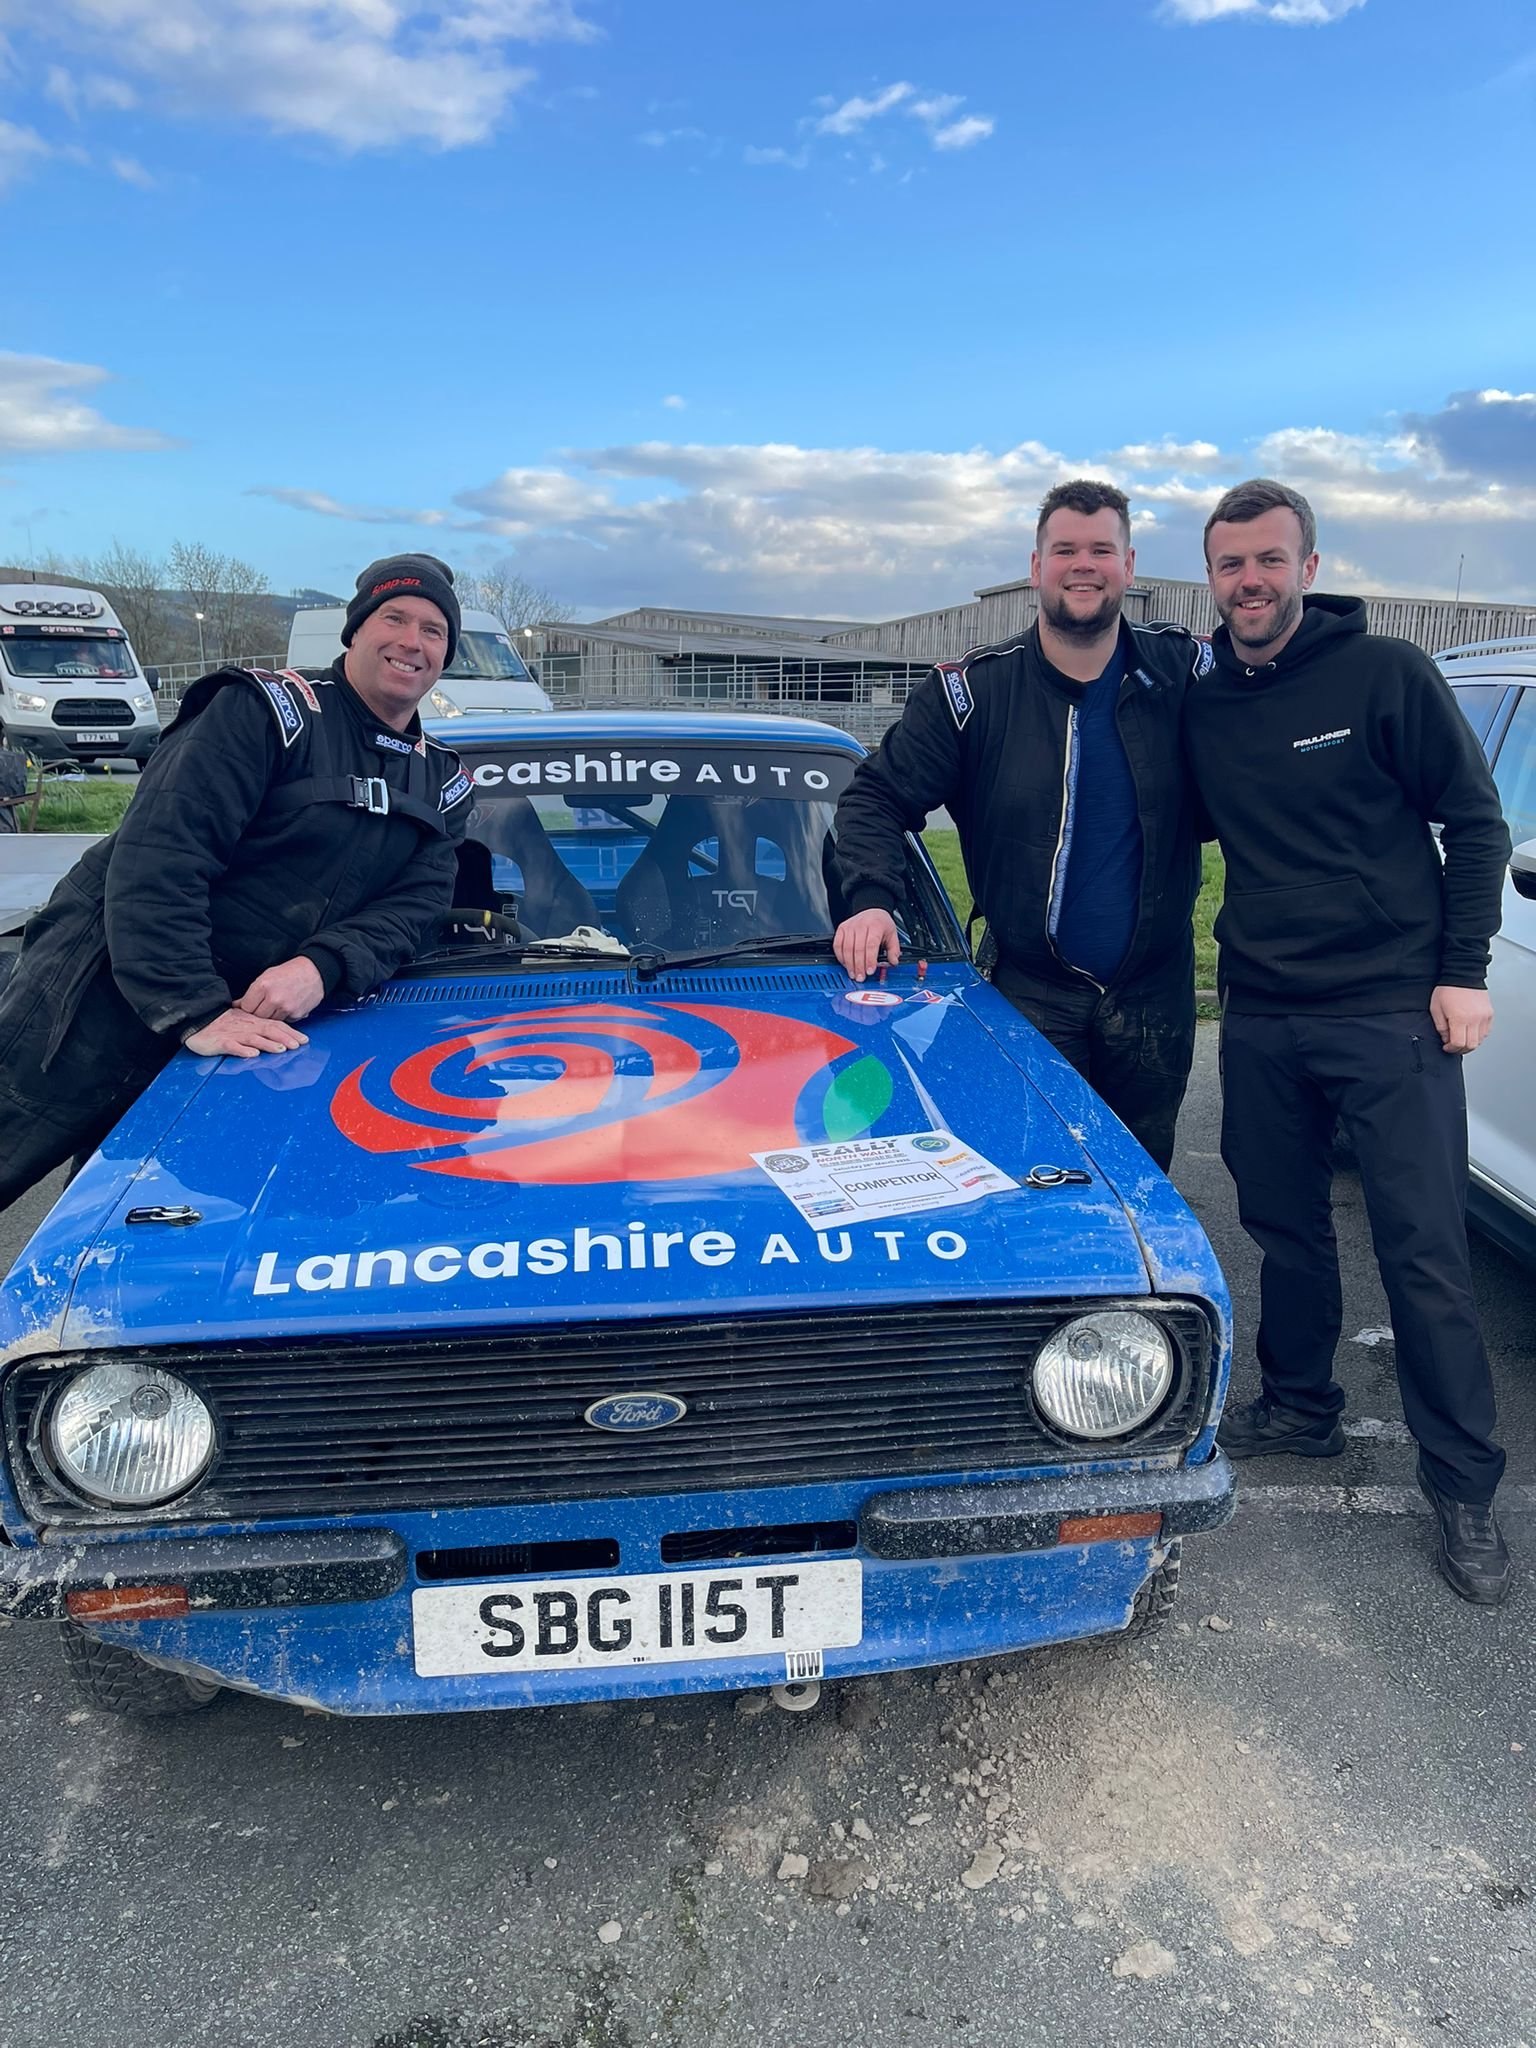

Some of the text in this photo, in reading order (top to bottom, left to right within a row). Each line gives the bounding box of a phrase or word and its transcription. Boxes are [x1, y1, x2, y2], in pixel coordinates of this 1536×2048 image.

[267, 682, 297, 727] sparco
[947, 672, 968, 712] sparco
[376, 734, 412, 754] sparco
[1293, 728, 1351, 748] FAULKNER
[1300, 738, 1345, 752] MOTORSPORT
[444, 775, 469, 803] sparco
[696, 763, 830, 790] AUTO
[811, 1139, 898, 1158] RALLY
[817, 1154, 857, 1164] NORTH
[860, 1148, 900, 1158] WALES
[844, 1170, 942, 1193] COMPETITOR
[253, 1221, 968, 1295] Lancashire AUTO
[609, 1401, 664, 1424] Ford
[479, 1574, 799, 1658] SBG 115T
[787, 1651, 820, 1678] TOW
